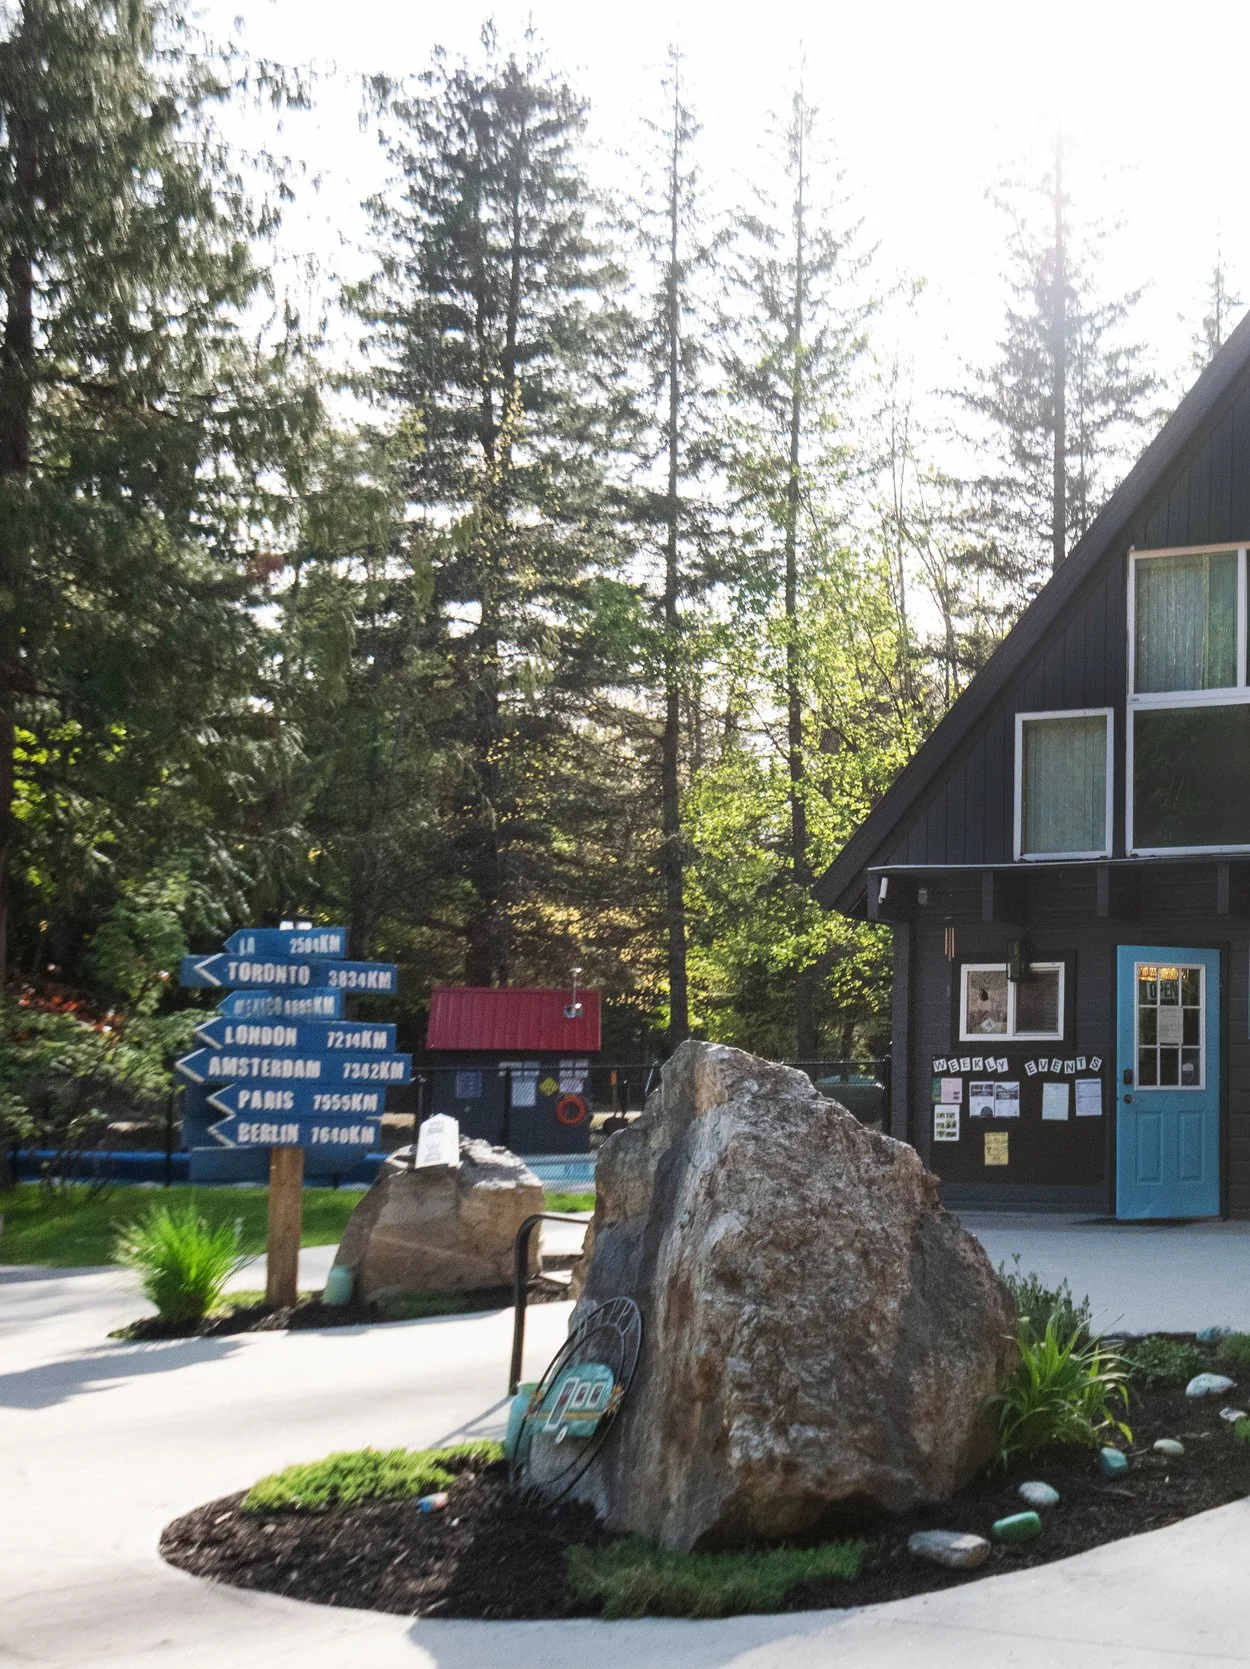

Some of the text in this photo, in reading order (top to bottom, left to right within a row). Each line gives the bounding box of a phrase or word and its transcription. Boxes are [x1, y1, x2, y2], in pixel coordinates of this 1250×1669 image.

[228, 961, 311, 986] TORONTO
[225, 1025, 388, 1049] LONDON 7214KM
[208, 1055, 405, 1080] AMSTERDAM 7342KM
[934, 1056, 1101, 1075] WEEKLY EVENTS
[238, 1089, 379, 1111] PARIS 7555KM
[238, 1122, 300, 1143] BERLIN
